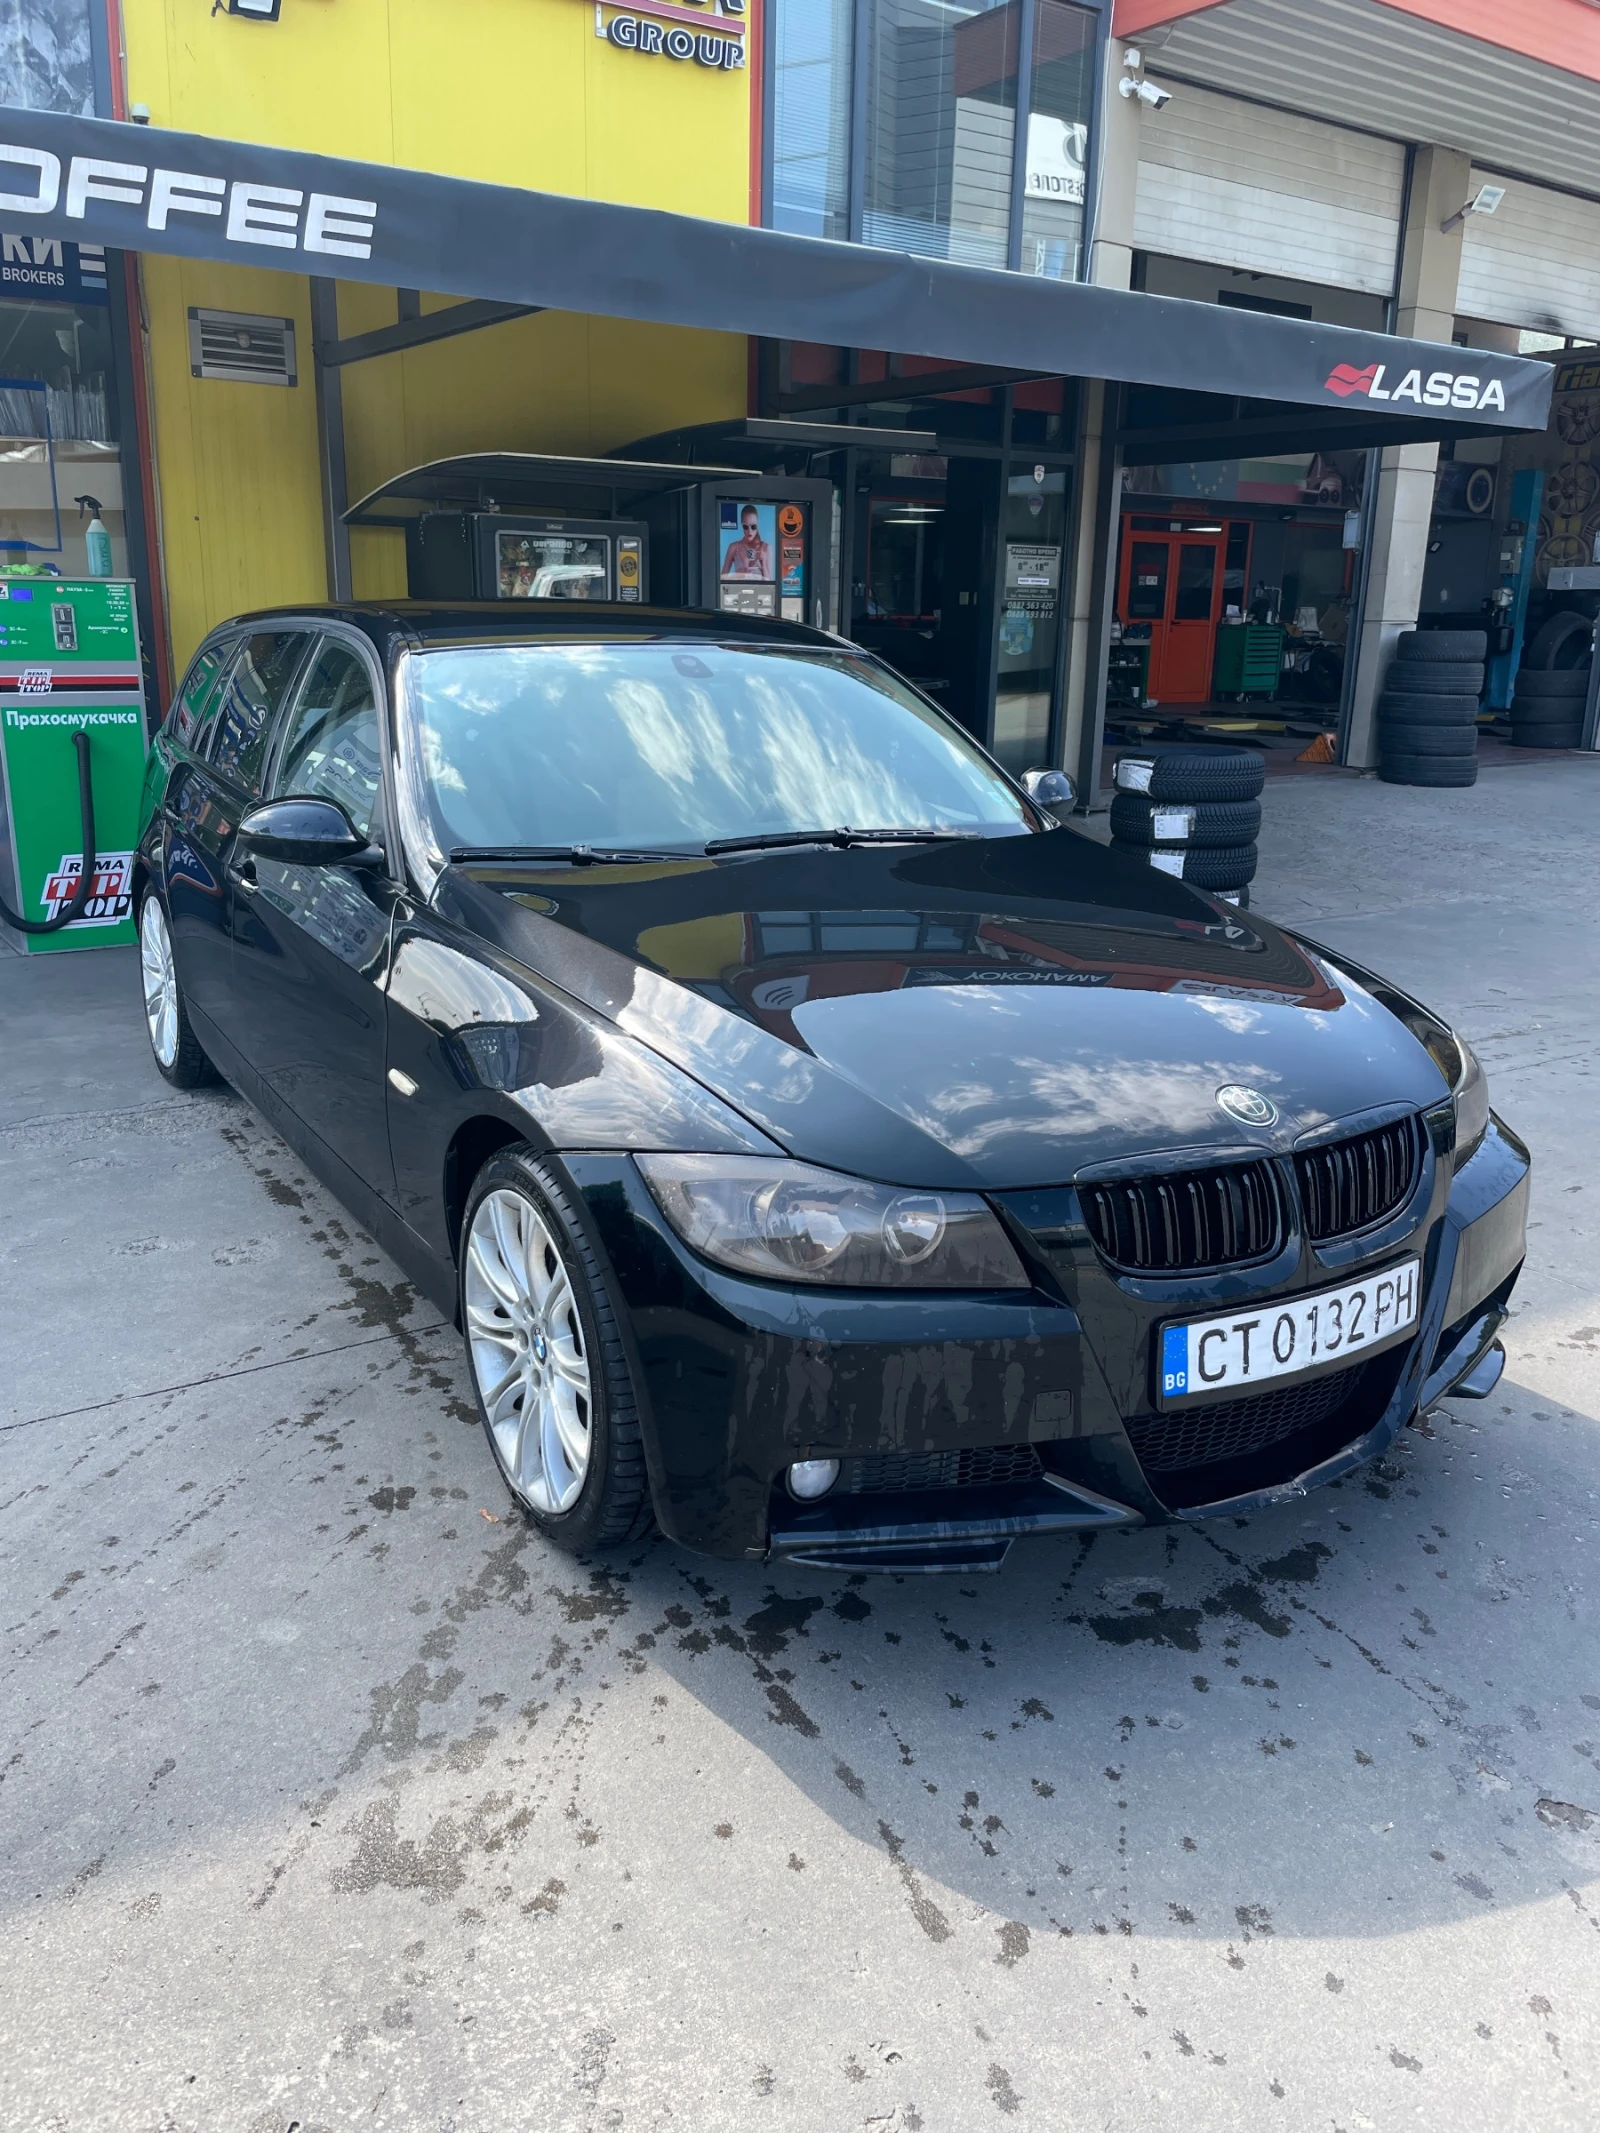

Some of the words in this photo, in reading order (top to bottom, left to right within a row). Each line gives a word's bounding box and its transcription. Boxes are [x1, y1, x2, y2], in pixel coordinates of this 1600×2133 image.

[608, 15, 744, 70] GROUP
[0, 144, 377, 259] OFFEE
[2, 267, 65, 286] BROKERS
[1368, 365, 1505, 411] LASSA
[6, 711, 137, 730] Прахосмукачка
[68, 860, 124, 873] RMA
[52, 875, 119, 898] TP
[61, 896, 128, 917] OP
[1198, 1319, 1261, 1383] CT
[1272, 1290, 1367, 1364] 0132
[1374, 1268, 1414, 1335] PH
[1164, 1371, 1186, 1391] BG
